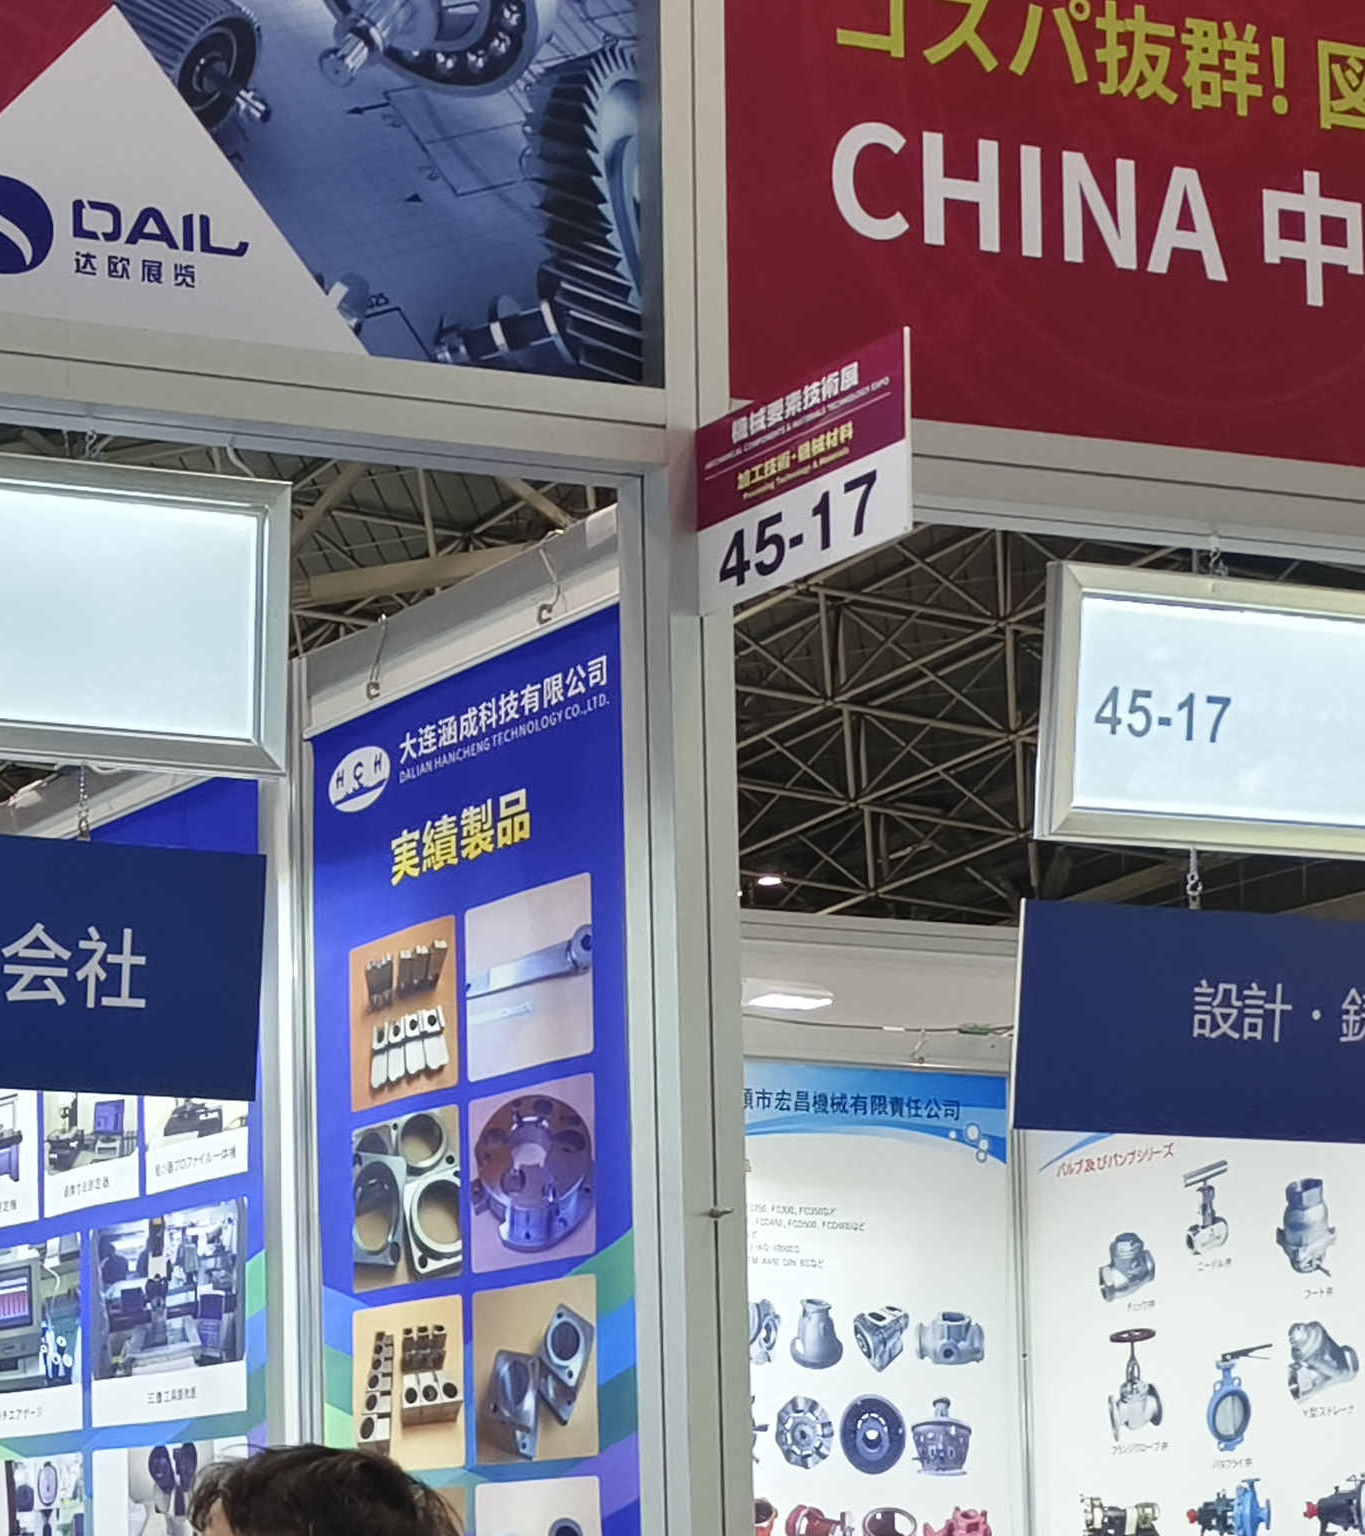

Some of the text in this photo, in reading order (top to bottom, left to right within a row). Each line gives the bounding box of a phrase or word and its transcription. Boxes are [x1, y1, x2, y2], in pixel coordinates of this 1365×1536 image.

[72, 199, 249, 257] DAIL
[832, 120, 1365, 308] CHINA 中
[74, 251, 196, 288] 达欧展览
[719, 469, 877, 587] 45-17
[399, 655, 608, 766] 大连涵成科技有限公司
[399, 760, 433, 784] DALIAN
[433, 737, 492, 775] HANCHENG
[492, 708, 564, 752] TECHNOLOGY
[1094, 686, 1232, 744] 45-17
[390, 788, 531, 886] 実績製品
